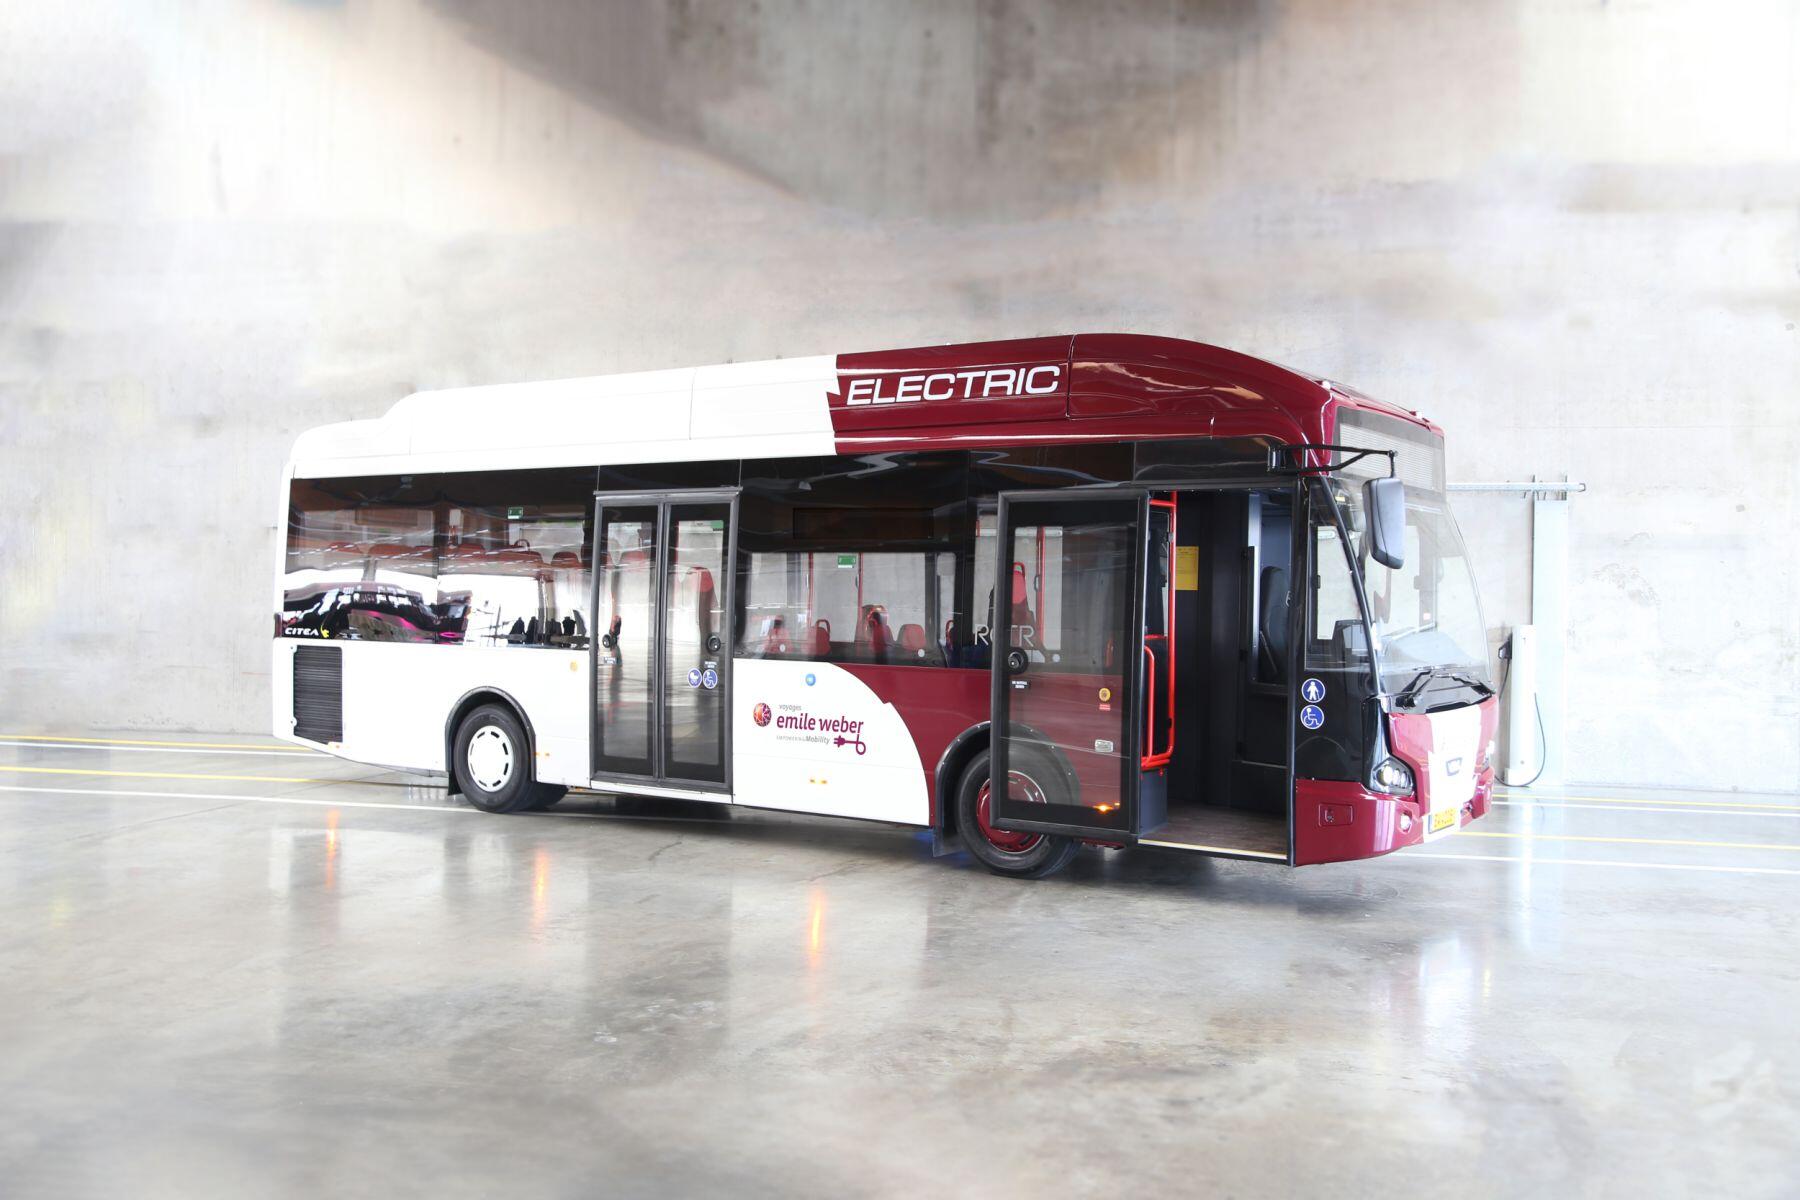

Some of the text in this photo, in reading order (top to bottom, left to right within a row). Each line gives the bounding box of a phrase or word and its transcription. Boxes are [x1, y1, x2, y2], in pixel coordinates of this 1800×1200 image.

[847, 366, 1060, 405] ELECTRIC
[284, 627, 319, 636] CITEA
[974, 623, 1034, 648] RTR
[779, 704, 802, 712] voyages
[776, 713, 864, 733] emile weber
